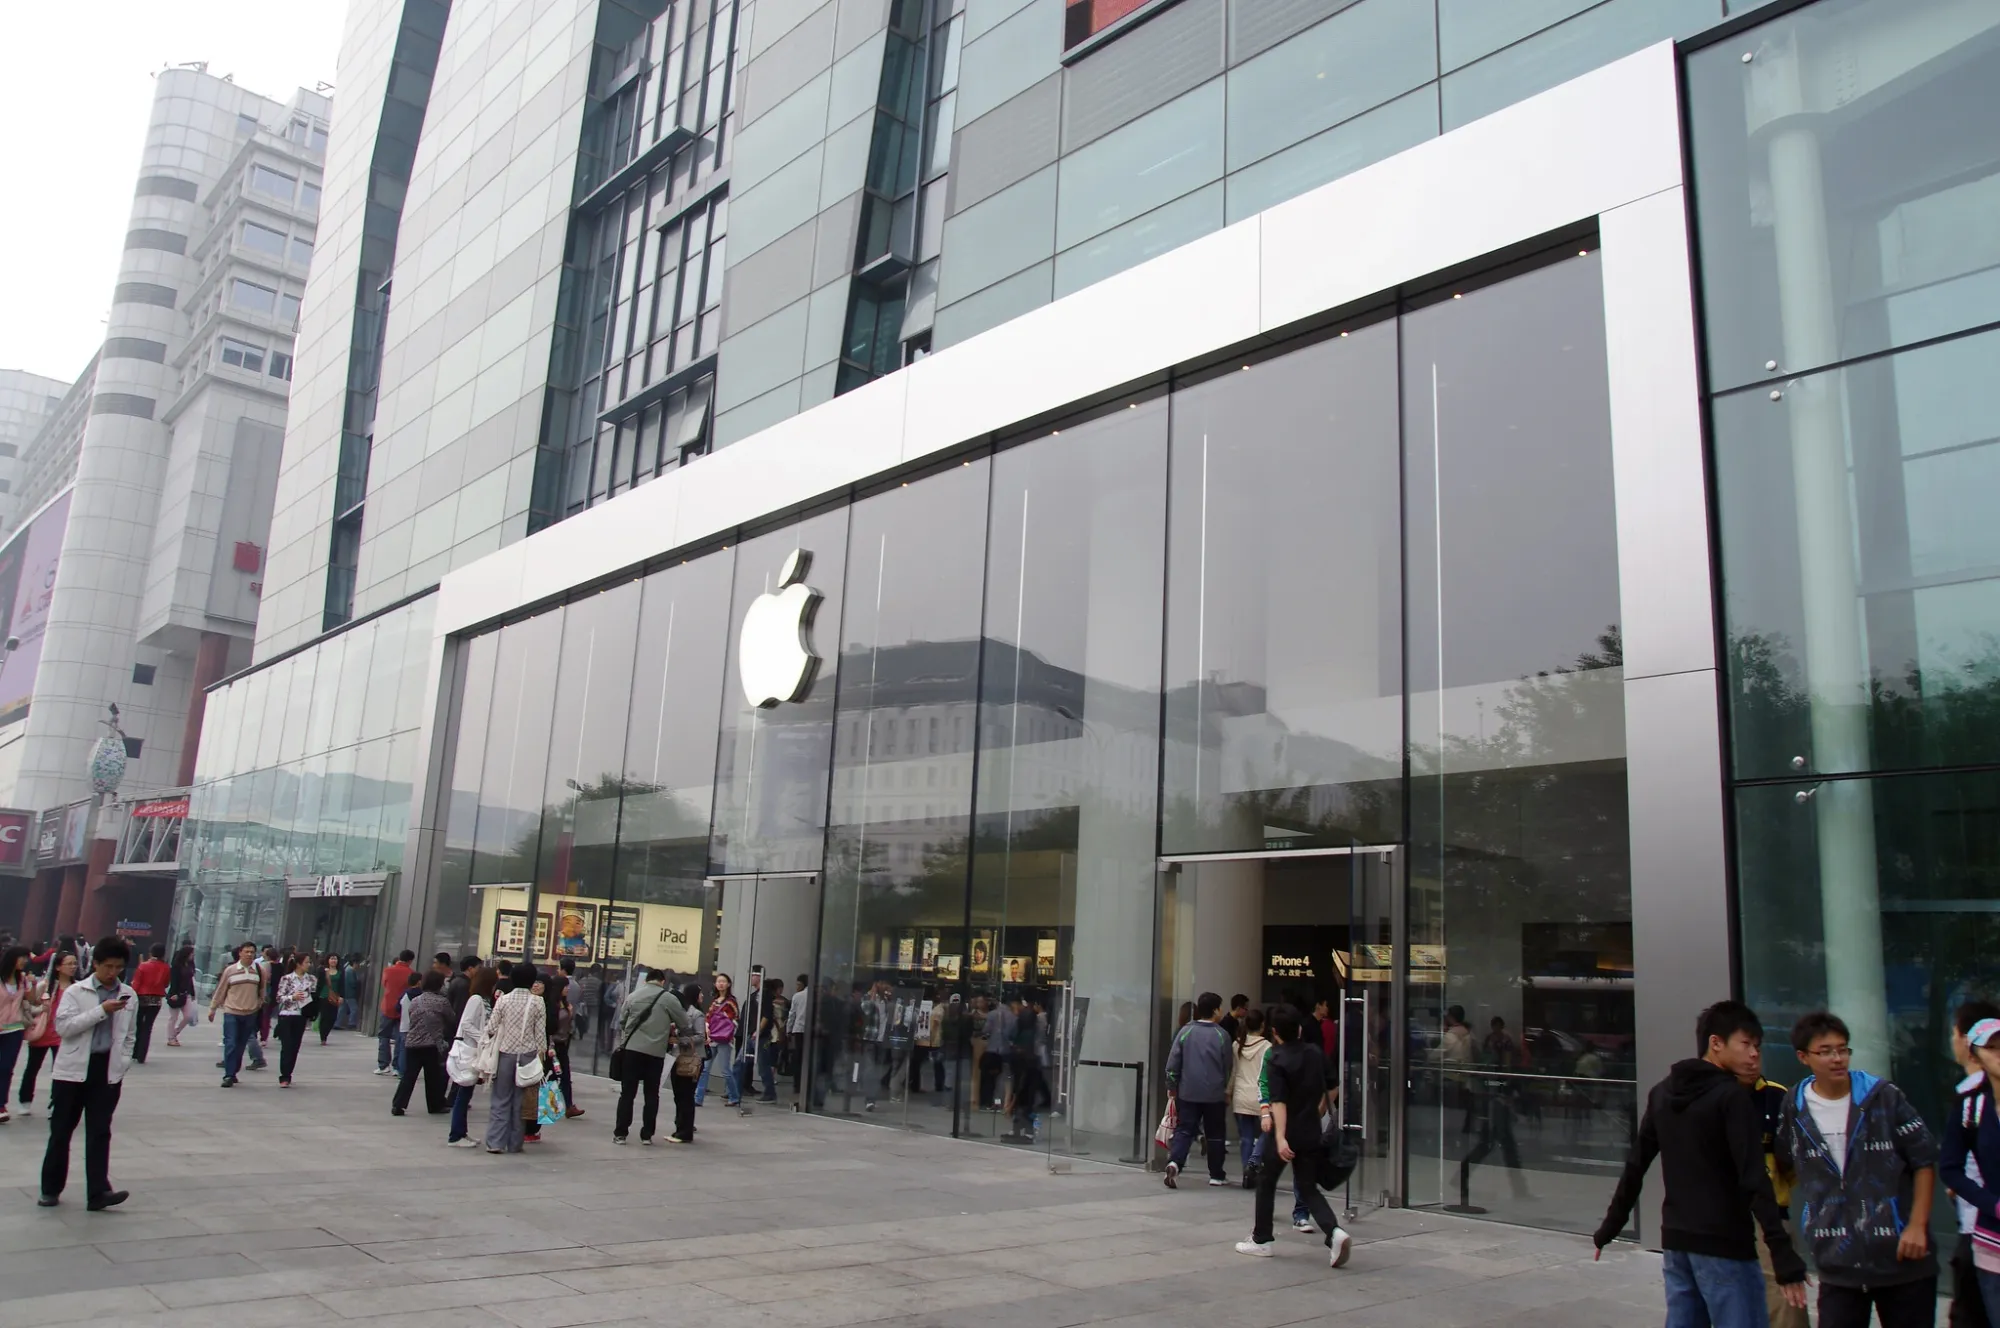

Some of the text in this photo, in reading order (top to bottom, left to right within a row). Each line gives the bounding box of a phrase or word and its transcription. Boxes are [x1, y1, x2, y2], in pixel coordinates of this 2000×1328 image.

[0, 824, 22, 843] C
[660, 928, 687, 943] iPad
[1271, 954, 1310, 967] iPhone 4
